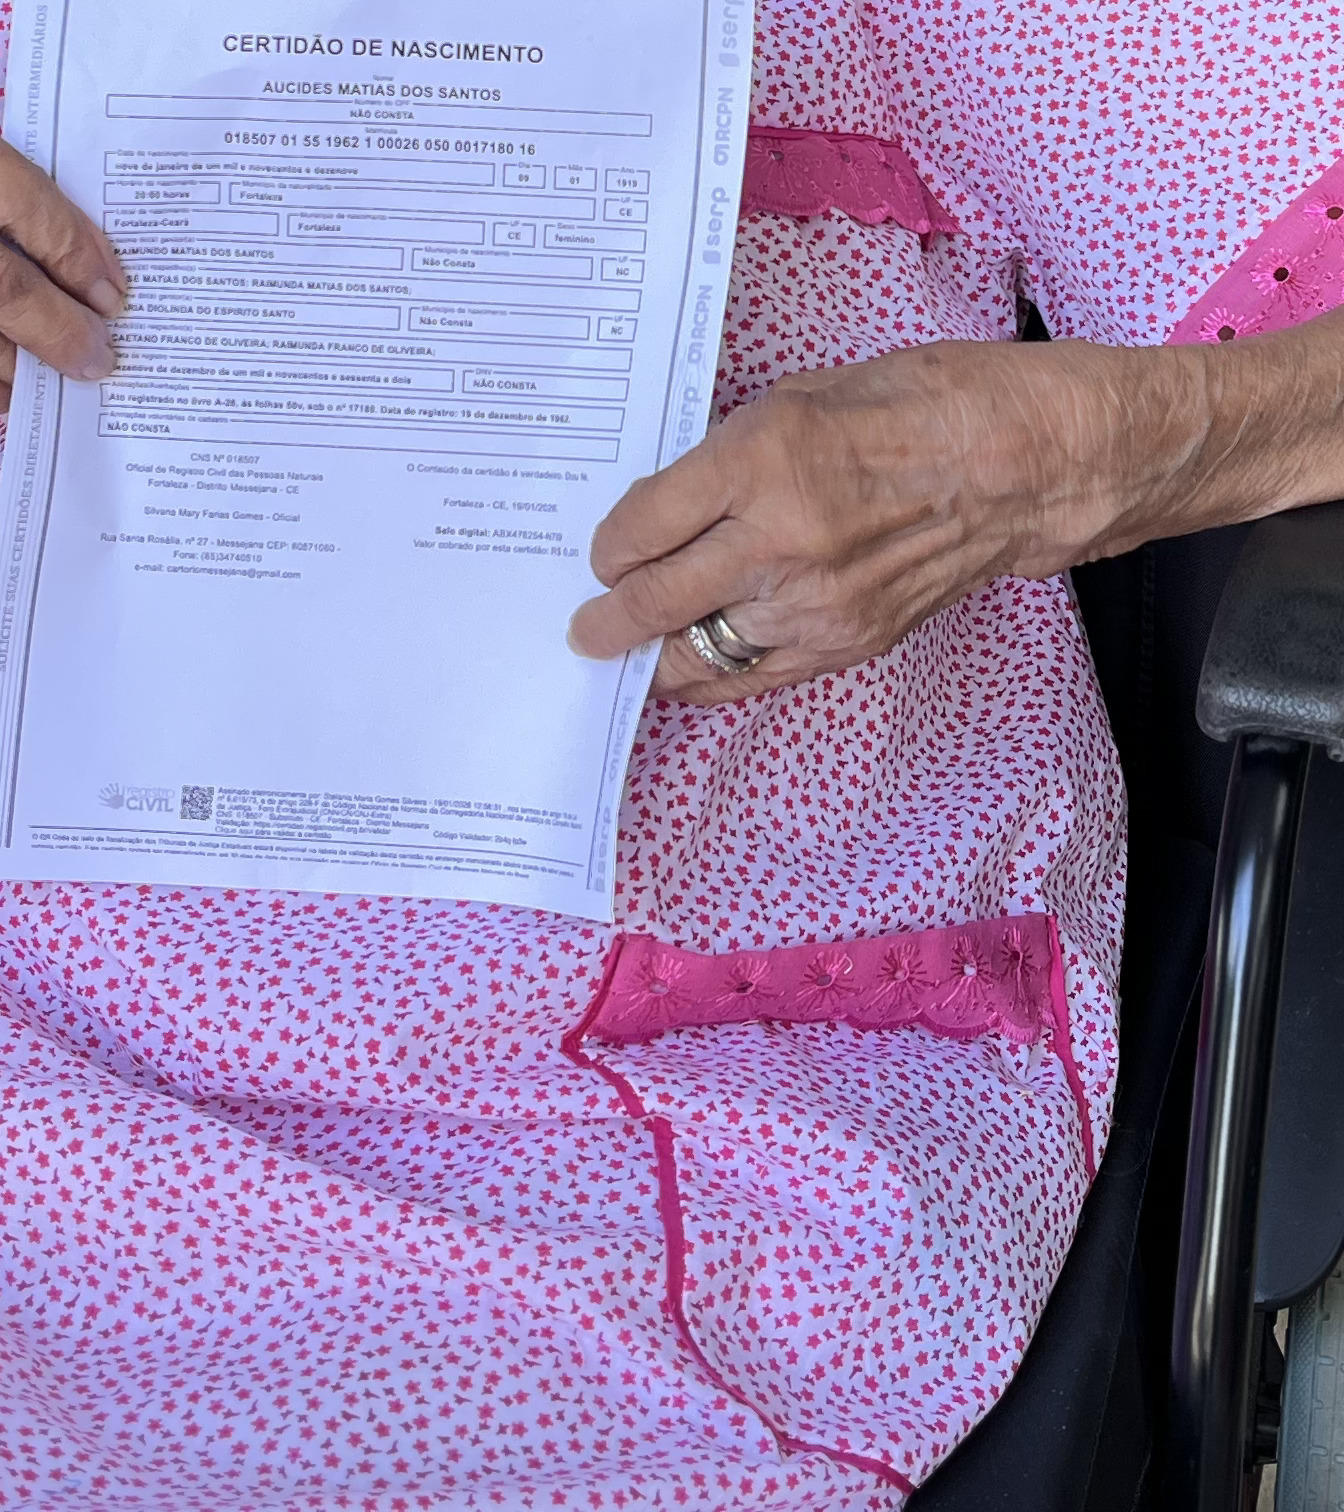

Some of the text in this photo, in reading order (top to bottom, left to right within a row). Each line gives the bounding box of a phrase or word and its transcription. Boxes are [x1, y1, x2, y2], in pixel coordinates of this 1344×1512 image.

[223, 33, 544, 64] CERTIDÃO DE NASCIMENTO
[27, 4, 48, 125] INTERMEDIÁRIOS
[263, 81, 501, 102] AUCIDES MATIAS DOS SANTOS
[350, 108, 414, 120] NÃO CONSTA
[224, 132, 536, 155] 018507 01 55 1962 1 00026 050 0017180 16
[142, 162, 153, 170] de
[156, 162, 189, 172] janeiro
[248, 164, 302, 173] novecentos
[314, 166, 358, 174] dezenove
[240, 191, 282, 201] Fortaleza
[619, 207, 632, 217] CE
[706, 186, 730, 247] serp
[114, 218, 189, 227] Fortaleza-Ceará
[298, 223, 341, 232] Fortaleza
[508, 231, 521, 240] CE
[555, 233, 595, 244] feminino
[114, 247, 274, 259] RAIMUNDO MATIAS DOS SANTOS
[423, 258, 475, 268] Não Consta
[616, 268, 629, 276] NC
[143, 275, 179, 283] MATIAS
[183, 275, 202, 285] DOS
[251, 278, 304, 289] RAIMUNDA
[307, 280, 343, 290] MATIAS
[346, 282, 366, 291] DOS
[197, 306, 210, 314] DO
[262, 308, 295, 318] SANTO
[420, 317, 473, 328] Não Consta
[161, 335, 201, 345] FRANCO
[206, 336, 218, 346] DE
[273, 340, 325, 350] RAIMUNDA
[328, 341, 367, 352] FRANCO
[371, 343, 384, 353] DE
[170, 366, 215, 376] dezembro
[219, 368, 229, 376] de
[250, 369, 265, 377] mil
[473, 379, 536, 390] NÃO CONSTA
[381, 406, 401, 415] Data
[404, 407, 415, 415] do
[474, 410, 485, 418] de
[488, 411, 533, 421] dezembro
[536, 413, 547, 421] de
[25, 371, 47, 476] DIRETAMENTE
[108, 422, 170, 433] NÃO CONSTA
[191, 453, 210, 462] CNS
[126, 463, 153, 473] Oficial
[156, 465, 166, 473] de
[207, 468, 226, 477] Civil
[229, 469, 244, 478] das
[247, 470, 284, 480] Pessoas
[288, 472, 323, 481] Naturais
[407, 464, 414, 472] O
[461, 466, 472, 475] da
[148, 479, 188, 488] Fortaleza
[286, 485, 299, 494] CE
[443, 497, 484, 509] Fortaleza
[10, 479, 34, 563] CERTIDÕES
[101, 533, 116, 542] Rua
[413, 539, 435, 549] Valor
[476, 543, 490, 553] por
[4, 566, 21, 603] SUAS
[126, 786, 175, 799] registro
[126, 797, 174, 813] CIVIL
